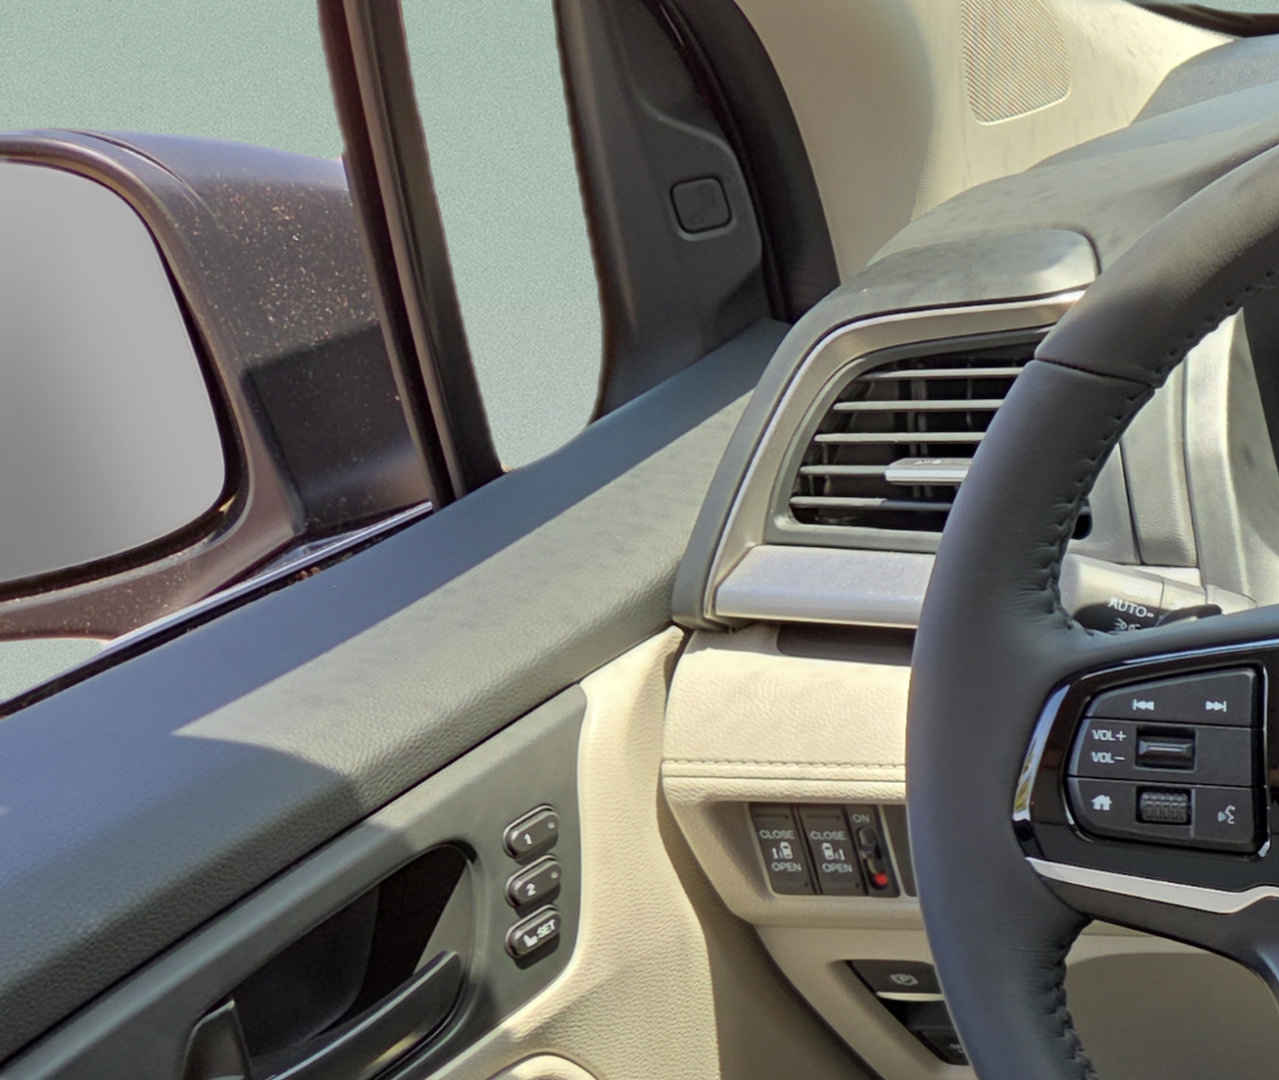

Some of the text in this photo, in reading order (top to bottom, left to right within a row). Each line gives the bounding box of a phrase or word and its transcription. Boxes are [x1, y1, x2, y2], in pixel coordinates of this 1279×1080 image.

[852, 813, 870, 823] ON
[524, 833, 533, 845] 1
[759, 829, 796, 840] CLOSE
[810, 830, 846, 841] CLOSE
[771, 862, 802, 872] OPEN
[822, 863, 853, 873] OPEN
[525, 883, 536, 896] 2
[537, 919, 556, 939] SET
